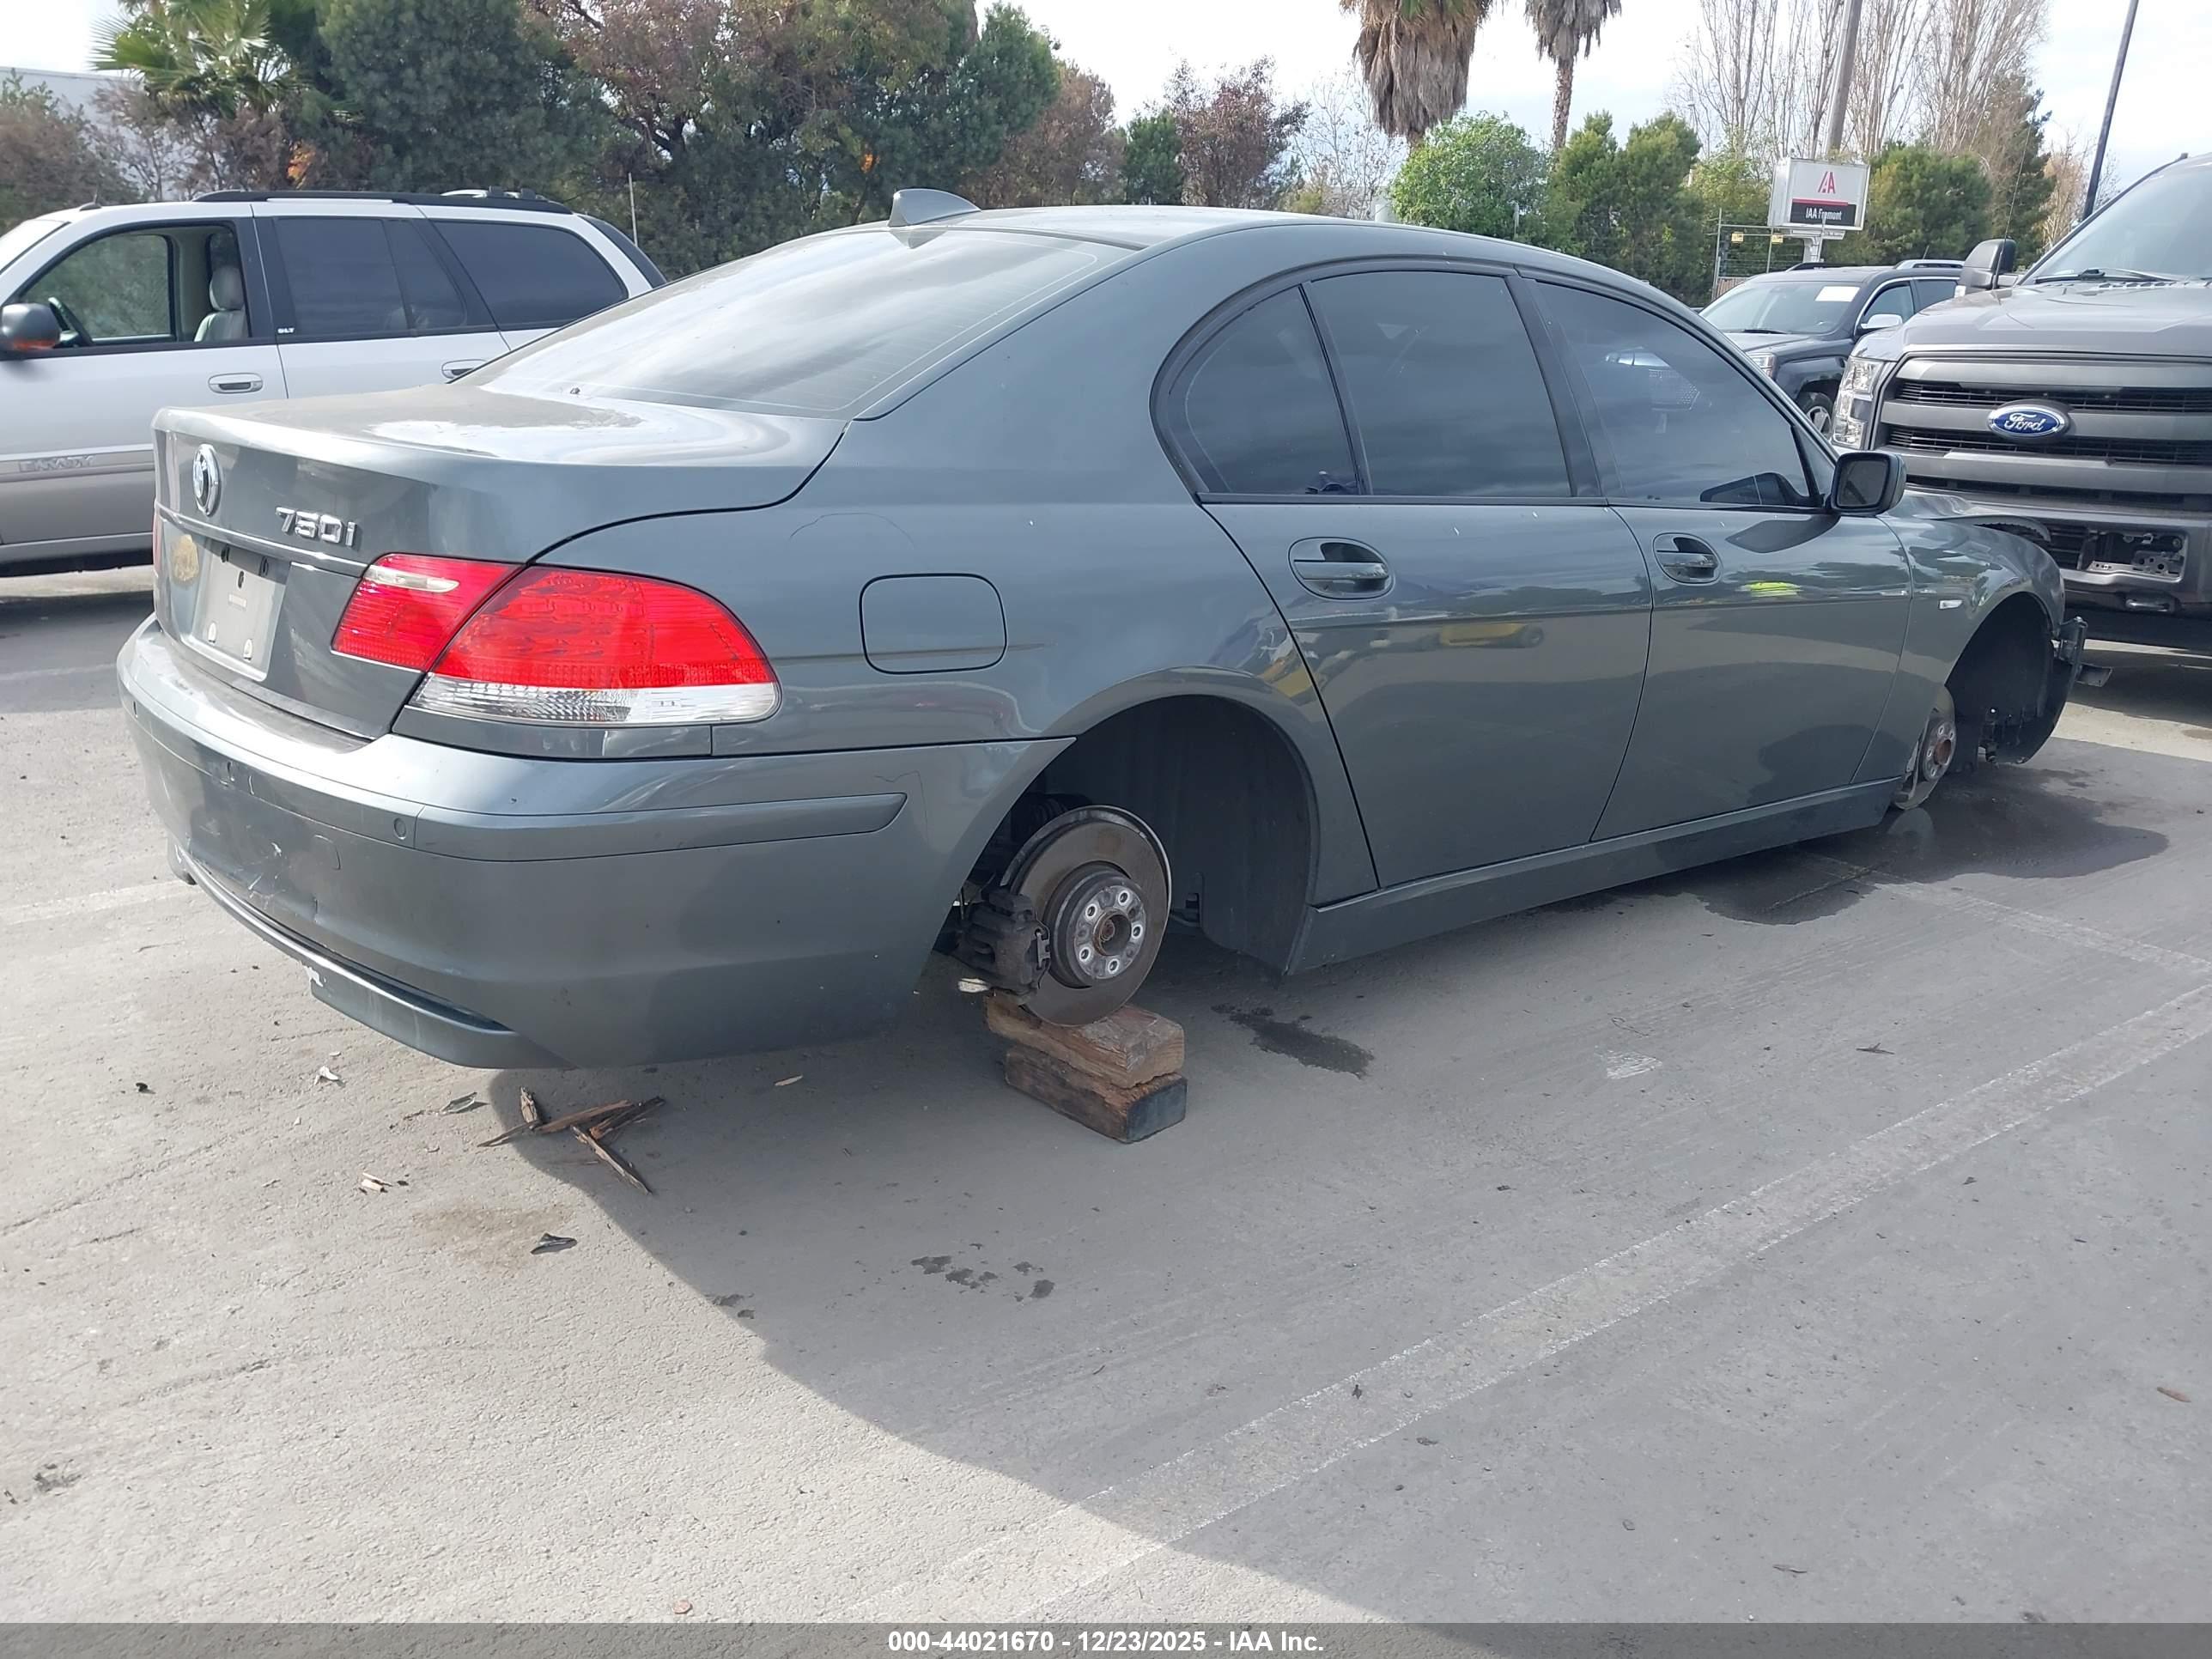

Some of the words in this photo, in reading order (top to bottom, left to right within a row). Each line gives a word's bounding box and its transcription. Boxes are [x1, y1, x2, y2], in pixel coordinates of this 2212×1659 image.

[1805, 207, 1817, 219] IAA
[2004, 412, 2046, 431] Ford
[275, 507, 356, 547] 750i
